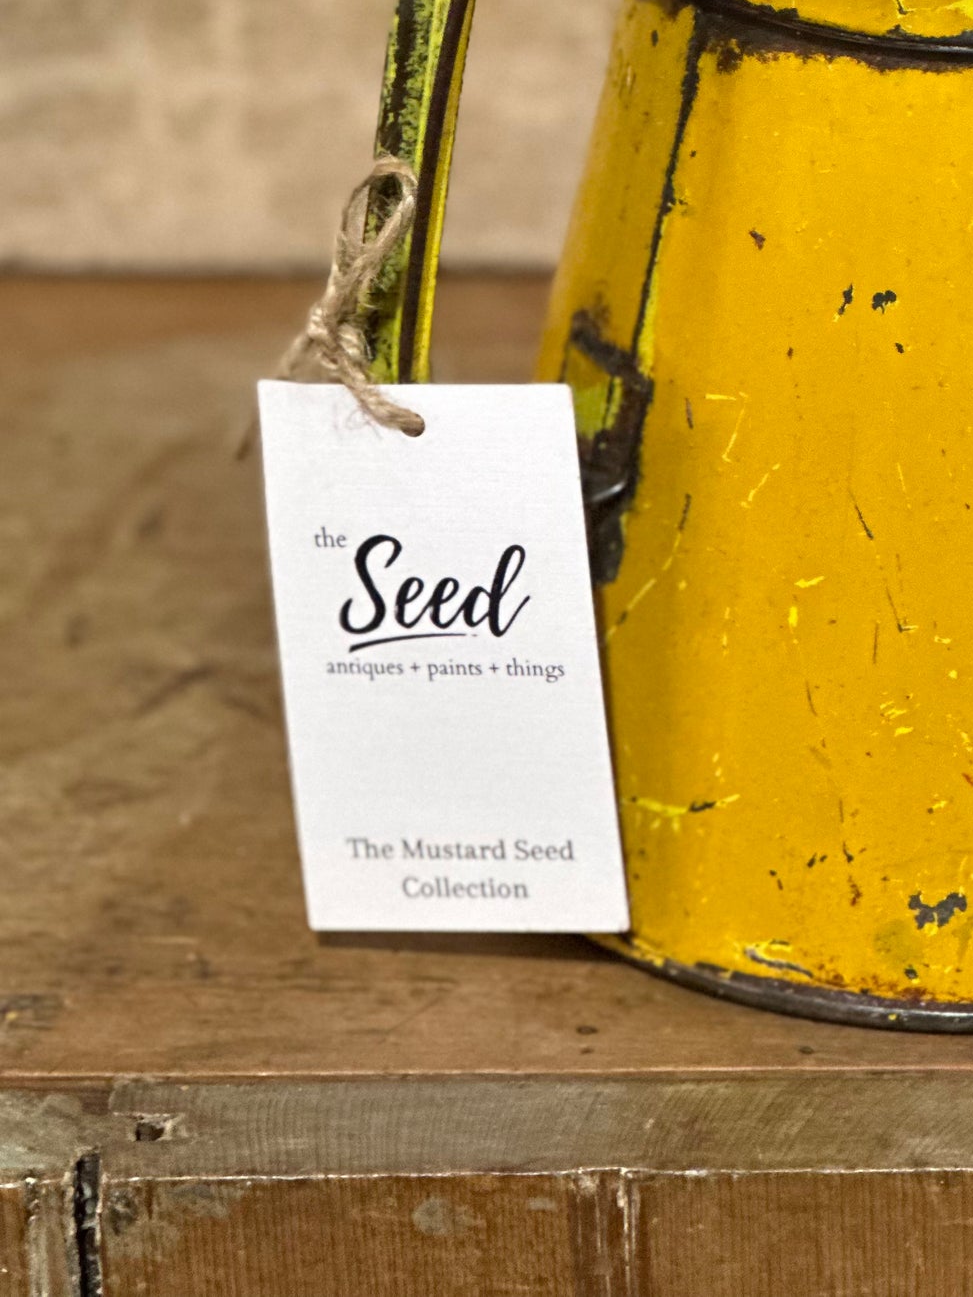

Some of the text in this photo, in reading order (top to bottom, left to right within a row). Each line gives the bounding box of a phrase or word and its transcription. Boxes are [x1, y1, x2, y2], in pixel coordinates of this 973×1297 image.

[314, 526, 531, 638] the Seed
[326, 658, 404, 681] antiques
[427, 658, 483, 682] paints
[506, 657, 566, 683] things
[346, 837, 575, 862] The Mustard Seed
[402, 875, 530, 900] Collection
